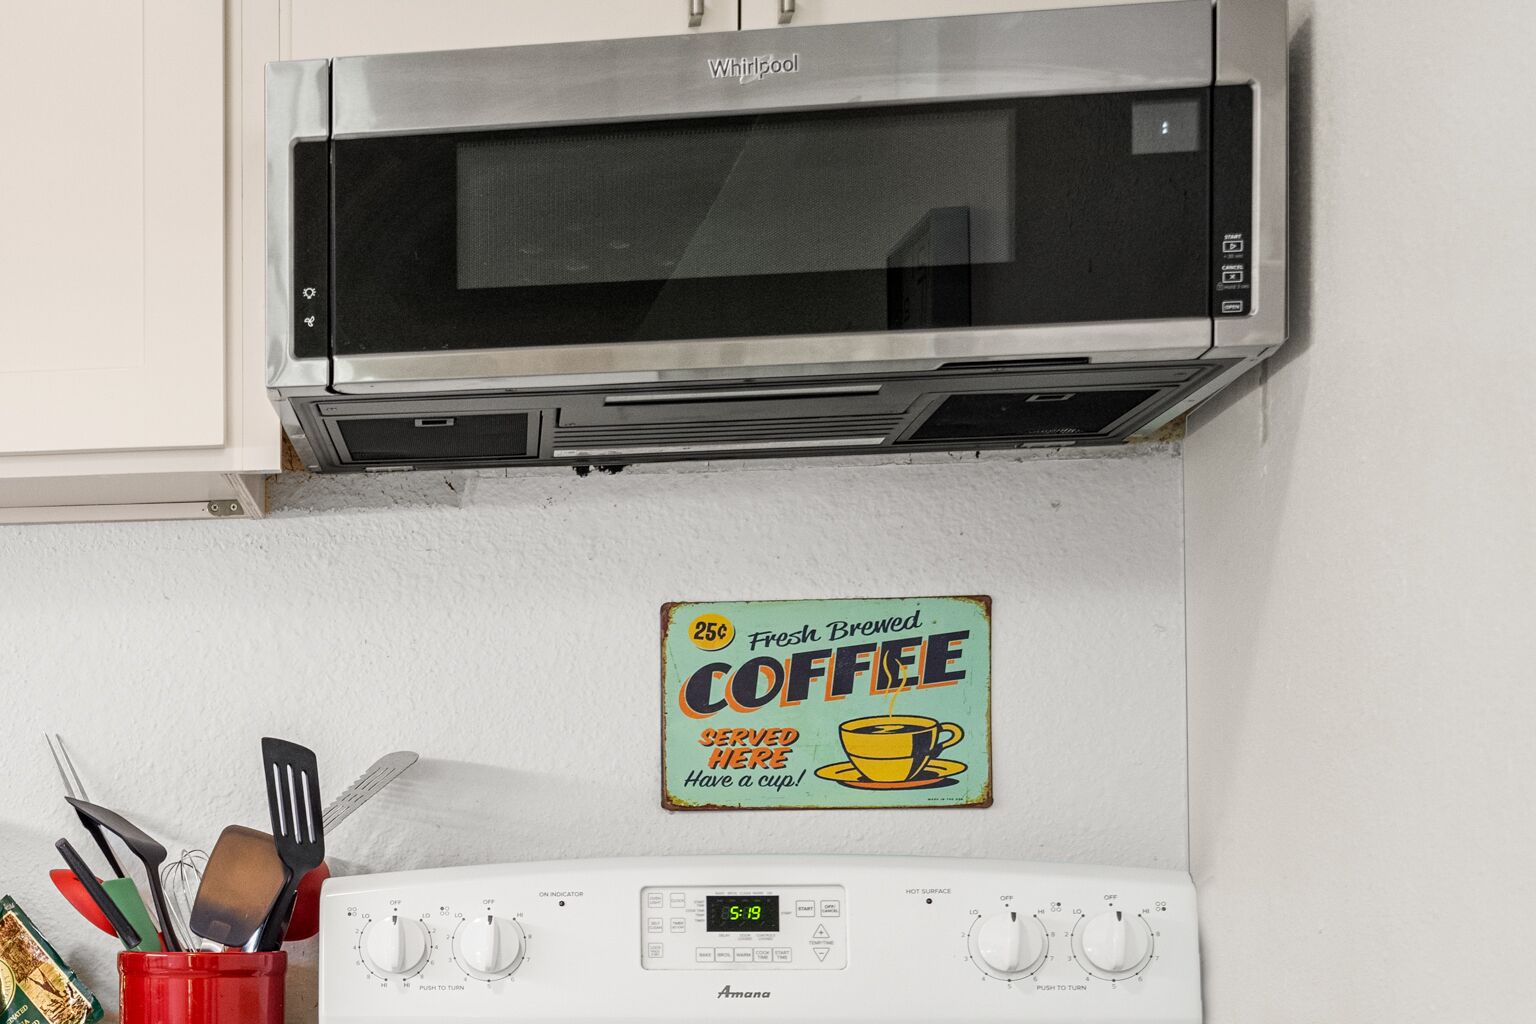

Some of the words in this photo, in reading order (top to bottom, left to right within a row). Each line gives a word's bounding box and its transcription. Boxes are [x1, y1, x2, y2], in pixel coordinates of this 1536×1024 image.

[707, 53, 799, 80] Whirlpool
[693, 620, 728, 642] 25¢
[747, 624, 822, 652] Fresh
[825, 609, 924, 642] Brewed
[678, 629, 971, 720] COFFEE
[698, 726, 801, 748] SERVED
[707, 747, 794, 771] HERE
[683, 768, 737, 789] Have
[738, 775, 754, 788] a
[754, 768, 806, 794] cup!
[549, 890, 584, 898] INDICATOR
[729, 905, 762, 921] 5:19
[716, 984, 772, 999] Amana
